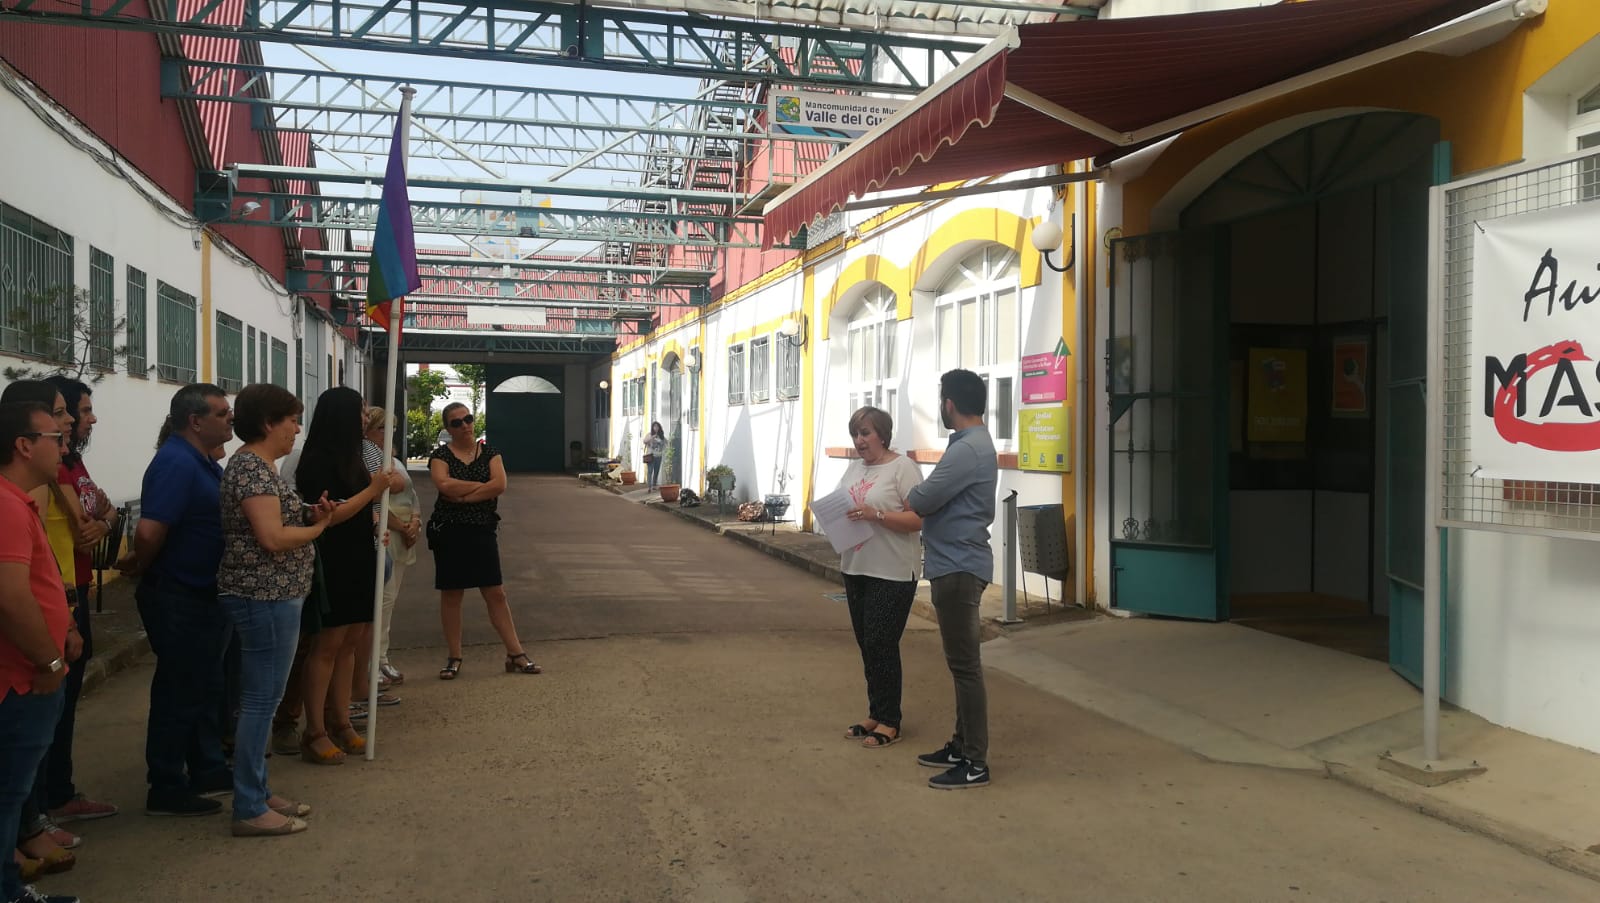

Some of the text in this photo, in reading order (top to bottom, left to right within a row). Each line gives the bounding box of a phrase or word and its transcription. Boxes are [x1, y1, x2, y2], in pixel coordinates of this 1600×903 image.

[805, 101, 867, 113] Mancomunidad
[869, 106, 880, 114] de
[805, 110, 886, 126] Valle del Gu
[1523, 248, 1600, 322] Au
[1485, 353, 1600, 417] MA
